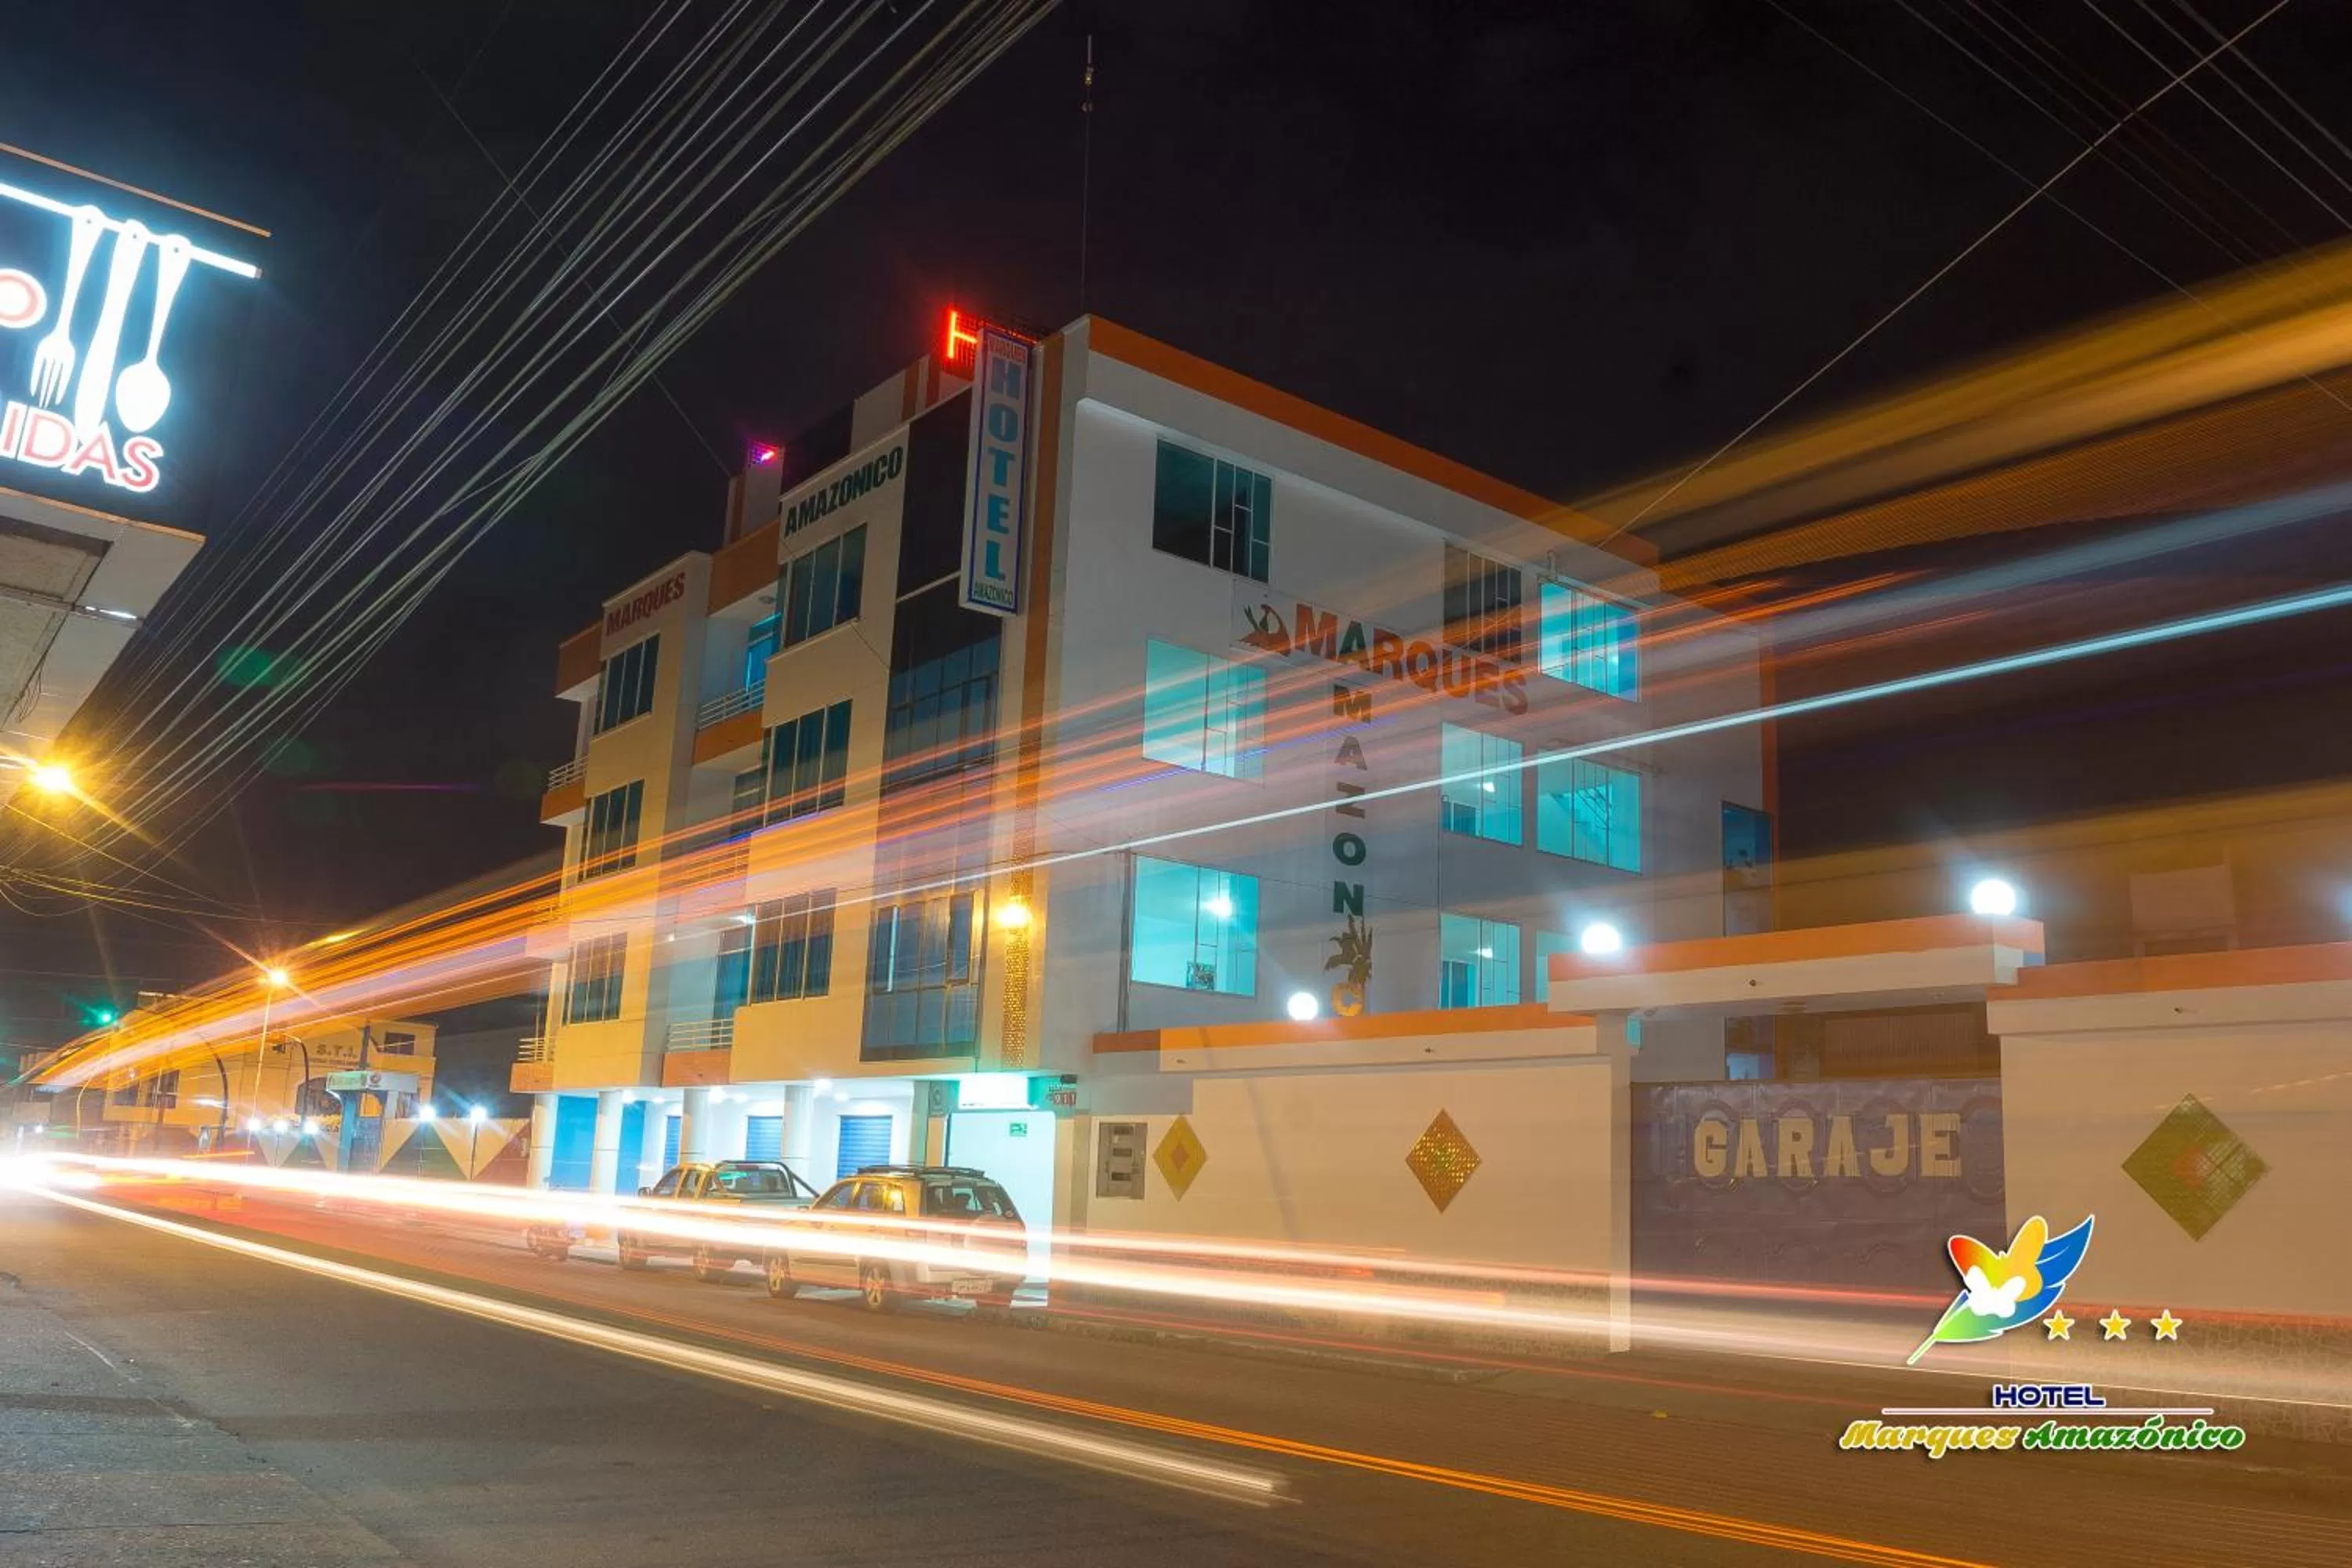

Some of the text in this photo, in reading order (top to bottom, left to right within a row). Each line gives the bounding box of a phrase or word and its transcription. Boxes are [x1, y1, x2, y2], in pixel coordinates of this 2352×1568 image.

[785, 445, 904, 538] AMAZONICO
[984, 358, 1021, 581] HOTEL
[606, 572, 686, 637] MARQUES
[1295, 602, 1528, 715] MARQUES
[1693, 1113, 1961, 1178] GARAJE
